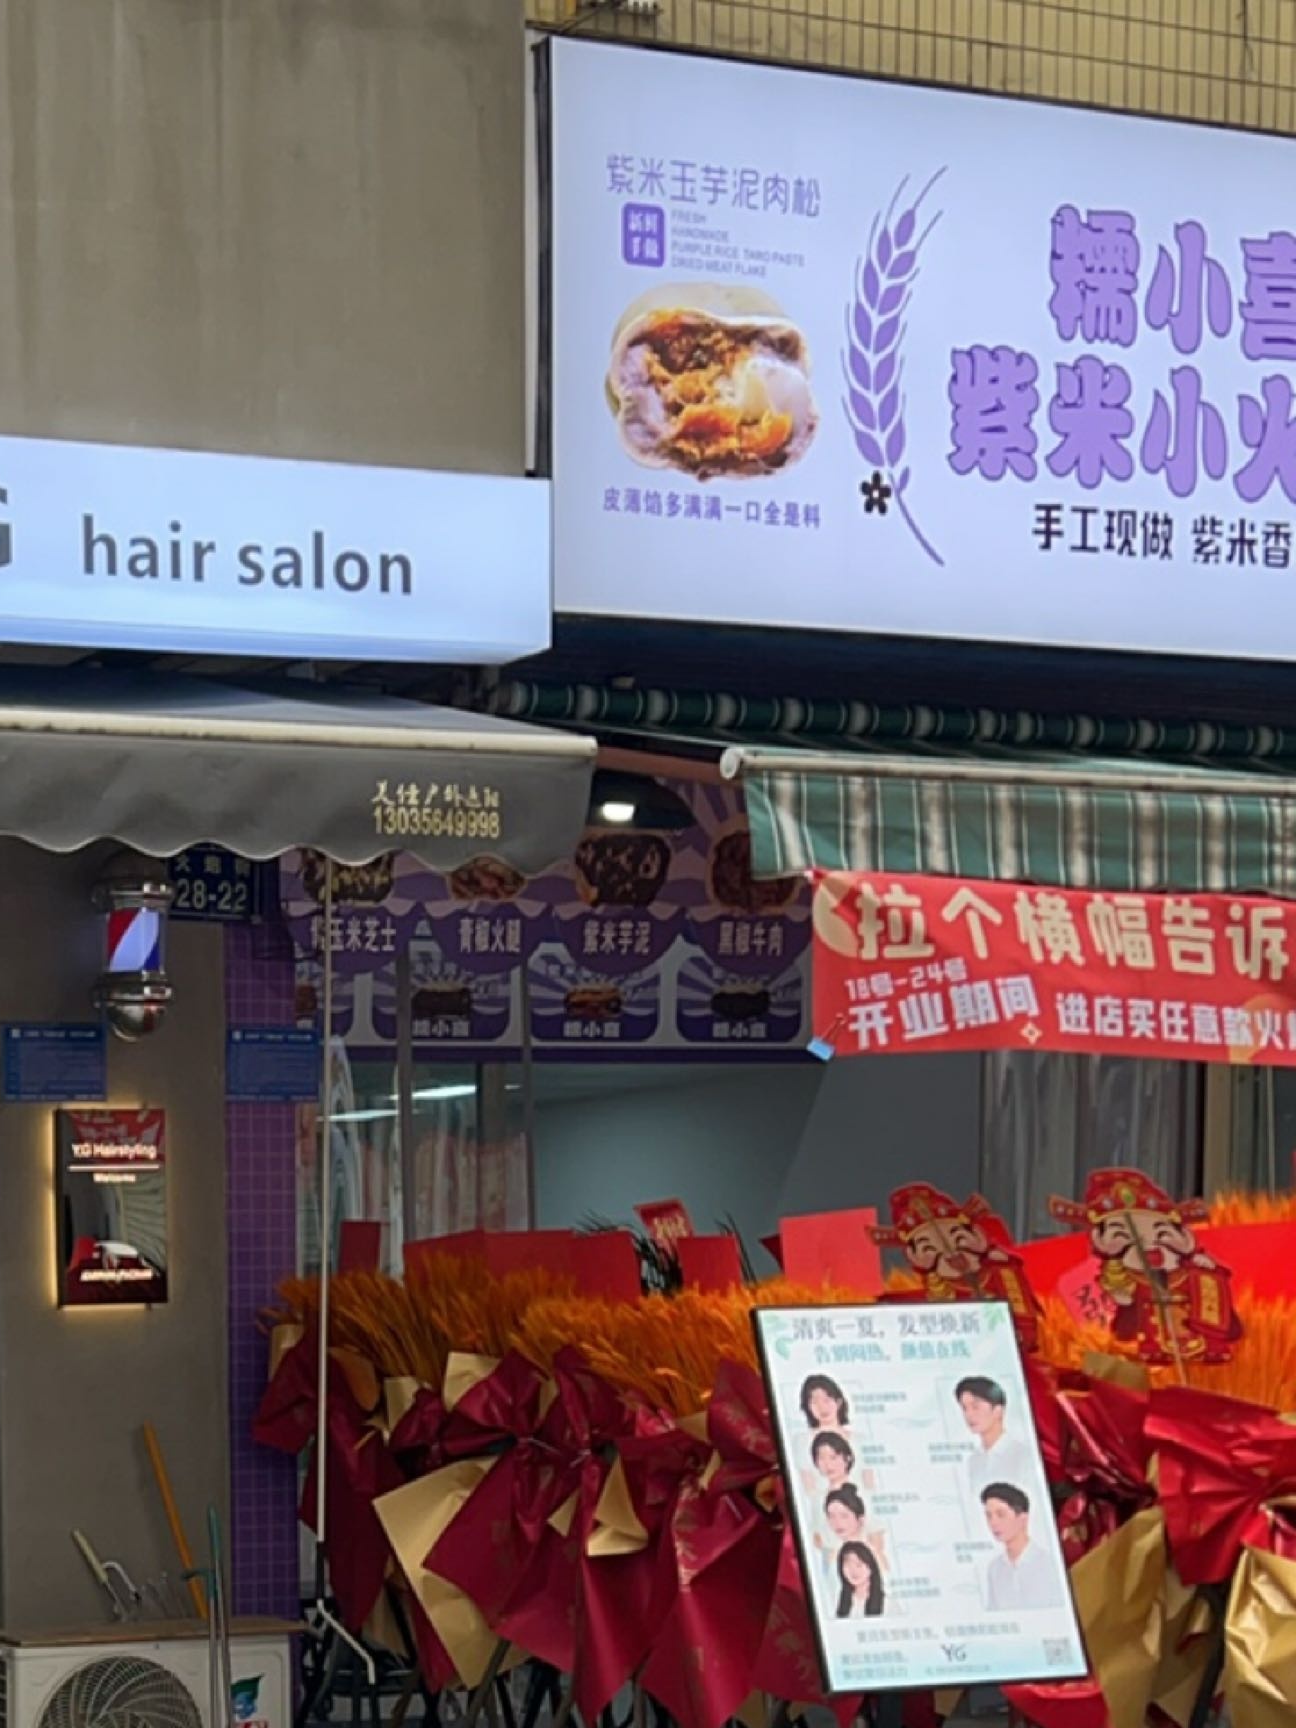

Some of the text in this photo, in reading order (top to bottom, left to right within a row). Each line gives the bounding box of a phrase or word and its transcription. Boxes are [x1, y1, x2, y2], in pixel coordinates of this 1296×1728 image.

[606, 154, 821, 217] 紫米玉芋泥肉松
[83, 514, 216, 582] hair
[238, 530, 413, 596] salon
[1032, 503, 1292, 569] 手工现做 紫米香
[176, 878, 248, 913] 28-22
[855, 881, 1290, 981] 拉个横幅告诉
[848, 974, 1041, 1050] 开业期间
[1056, 992, 1296, 1050] 进店买任意款火
